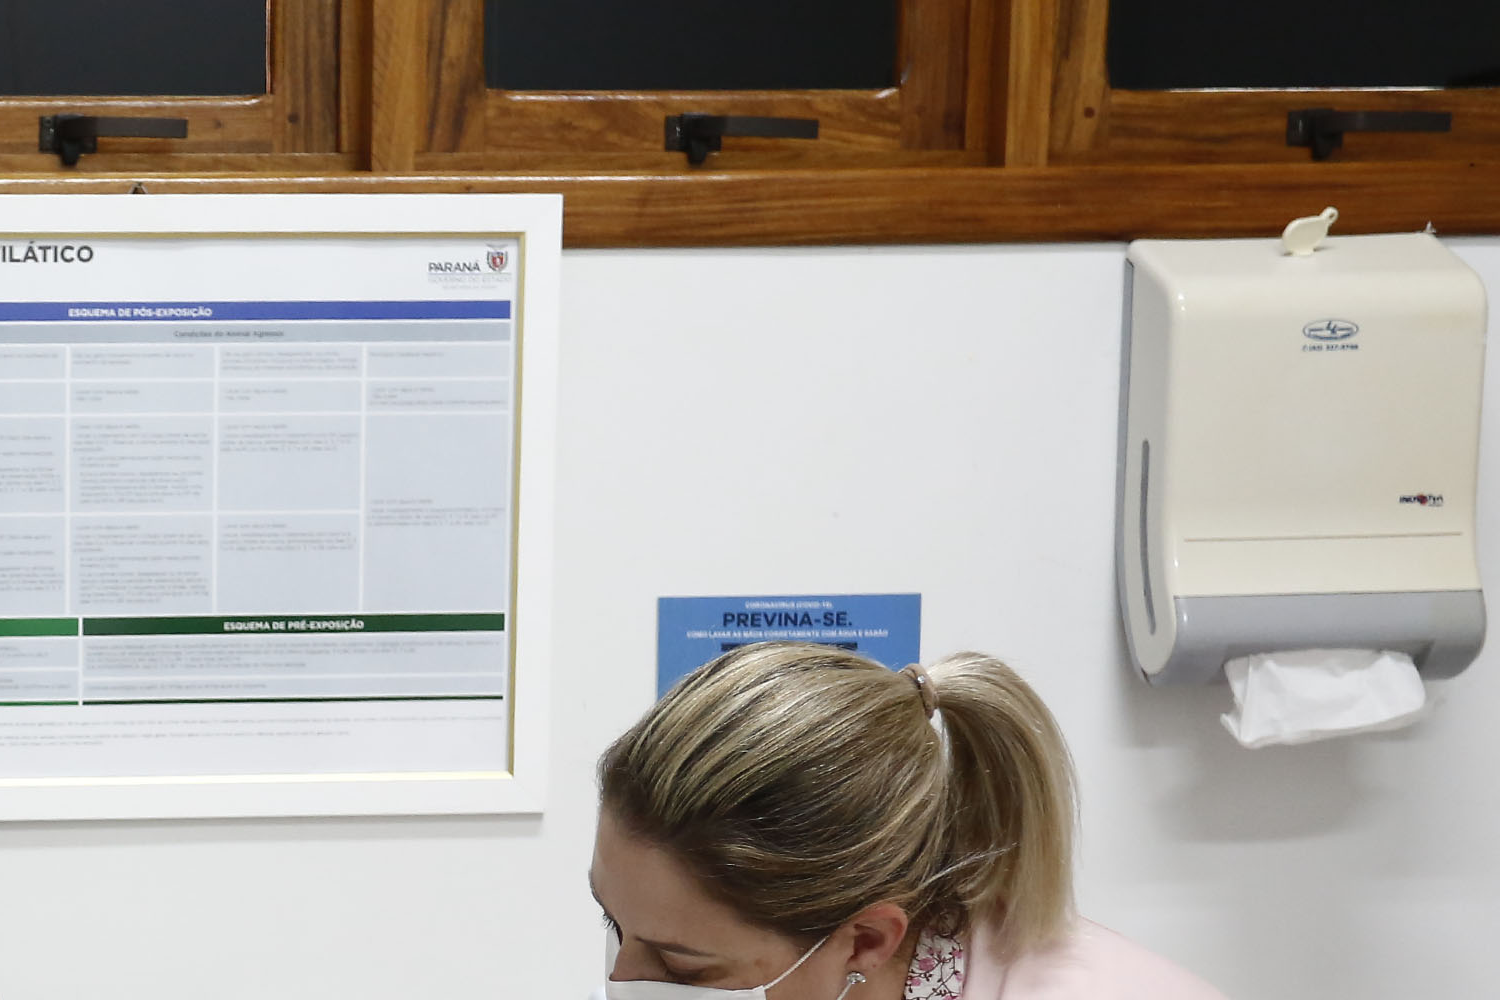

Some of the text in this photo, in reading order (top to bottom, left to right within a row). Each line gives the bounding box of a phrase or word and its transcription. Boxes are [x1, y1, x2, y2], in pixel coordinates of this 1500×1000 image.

[68, 308, 116, 318] ESQUEMA
[118, 308, 132, 317] DE
[223, 618, 364, 631] ESQUEMA DE PRÉ-EXPOSIÇÃO
[723, 611, 853, 628] PREVINA-SE.
